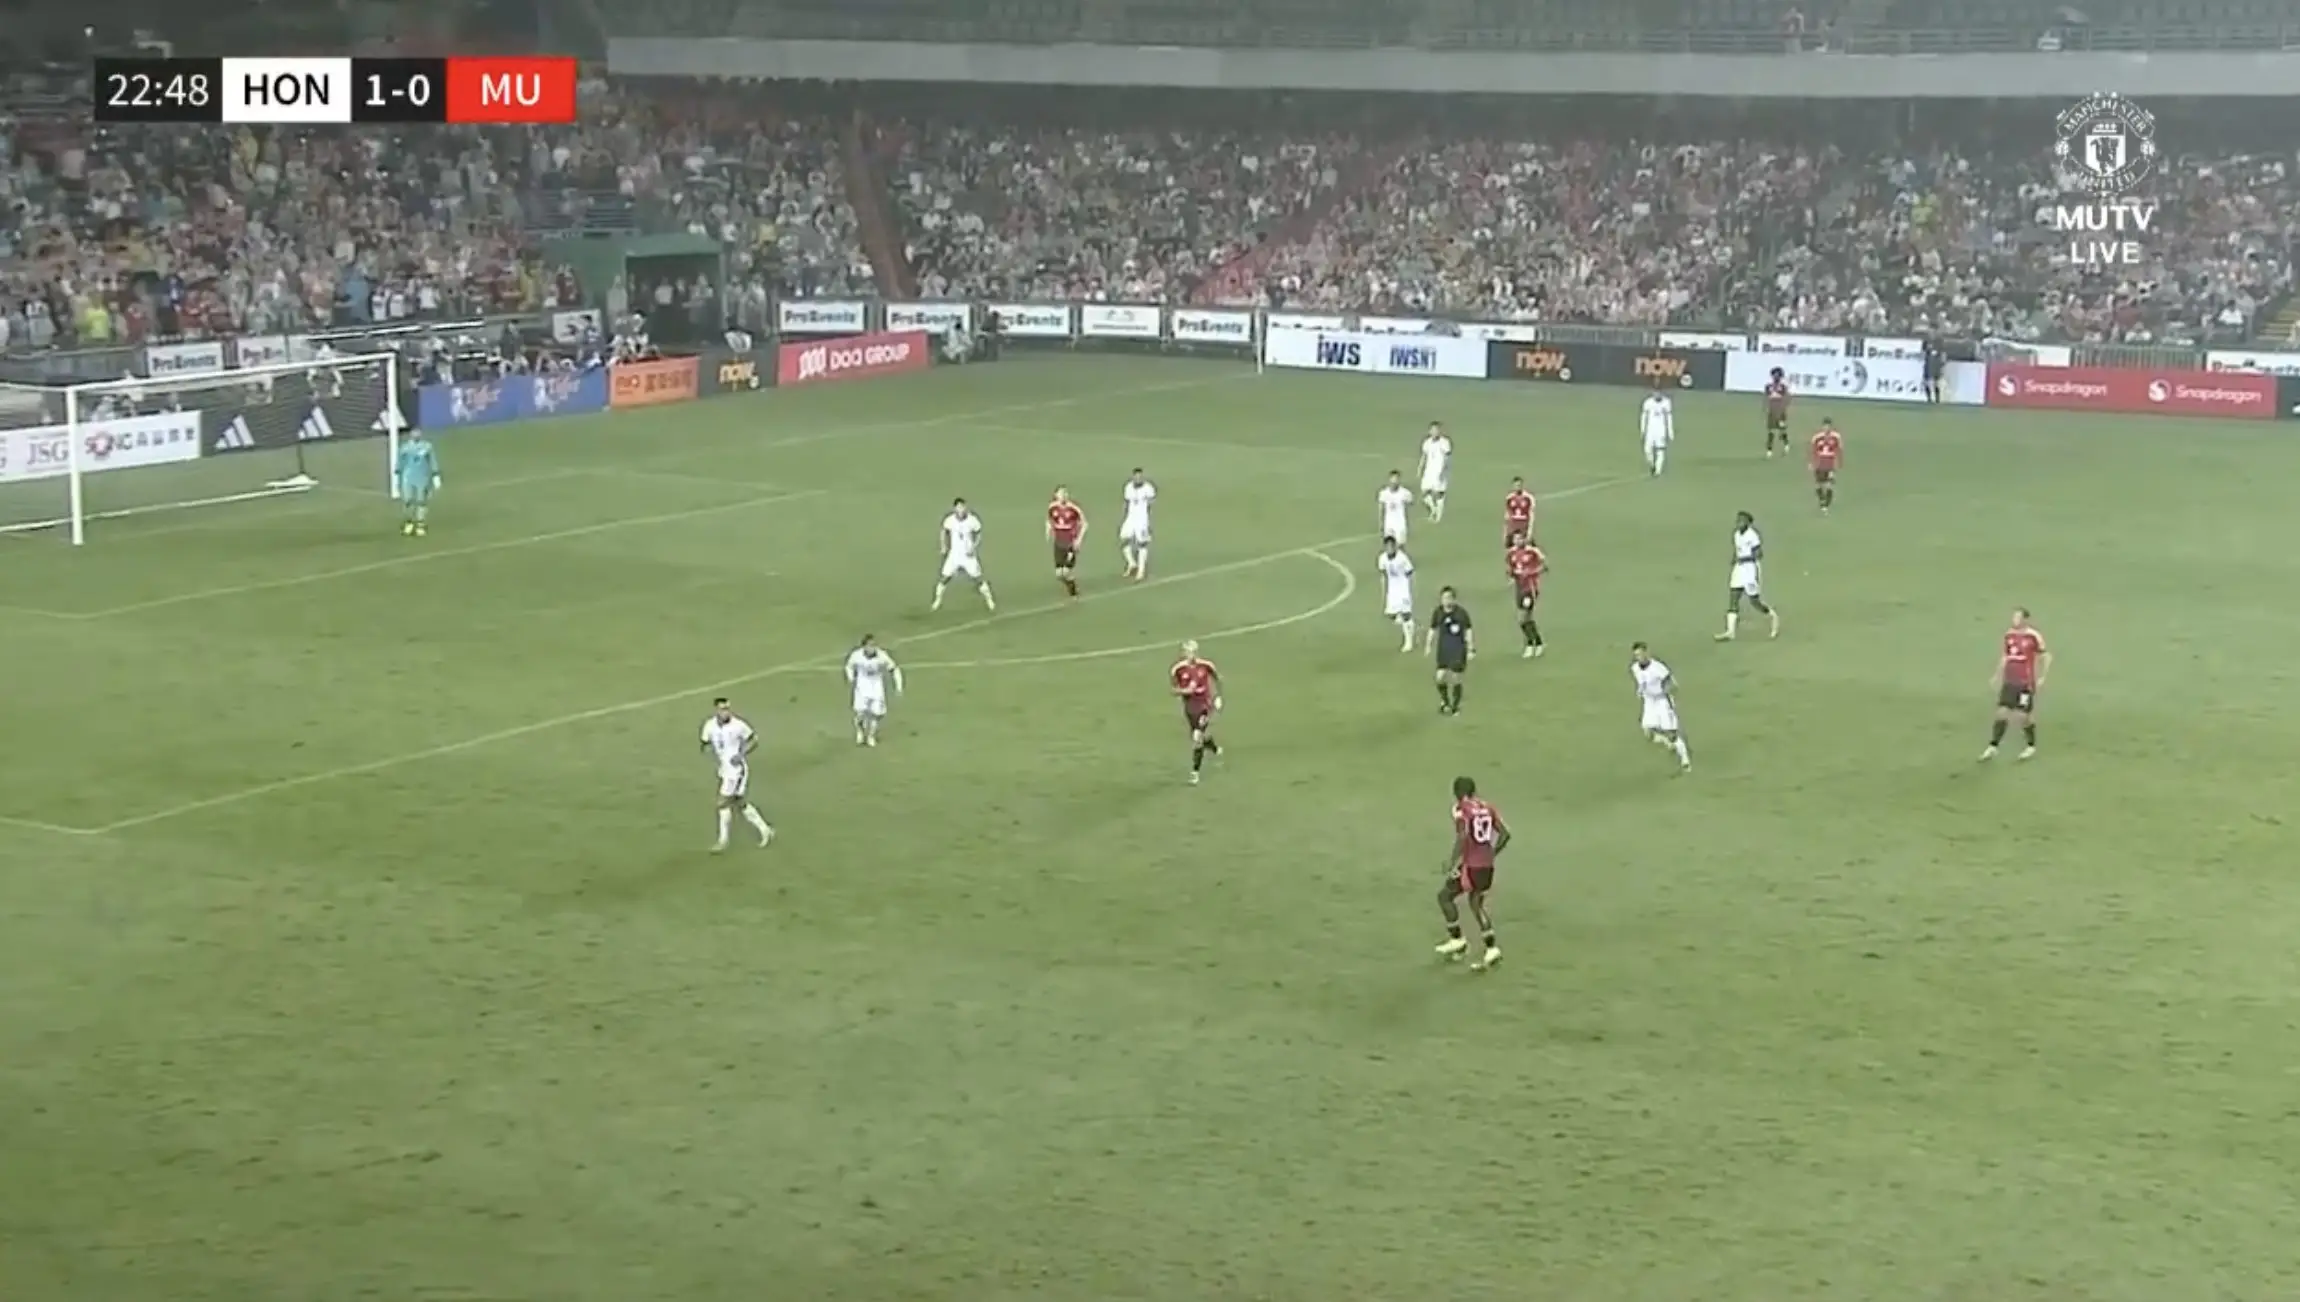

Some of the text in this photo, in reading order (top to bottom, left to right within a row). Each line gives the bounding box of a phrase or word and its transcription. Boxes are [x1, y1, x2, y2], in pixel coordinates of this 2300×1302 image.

[785, 309, 856, 324] ProEvents
[1001, 312, 1064, 327] roEvents
[1178, 317, 1244, 334] ProEvents
[865, 342, 911, 365] GROUP
[1516, 350, 1568, 372] now
[152, 354, 217, 373] ProEvents
[1635, 356, 1687, 379] now
[2024, 379, 2107, 398] Snapdragon
[2176, 384, 2262, 404] Snapdragon
